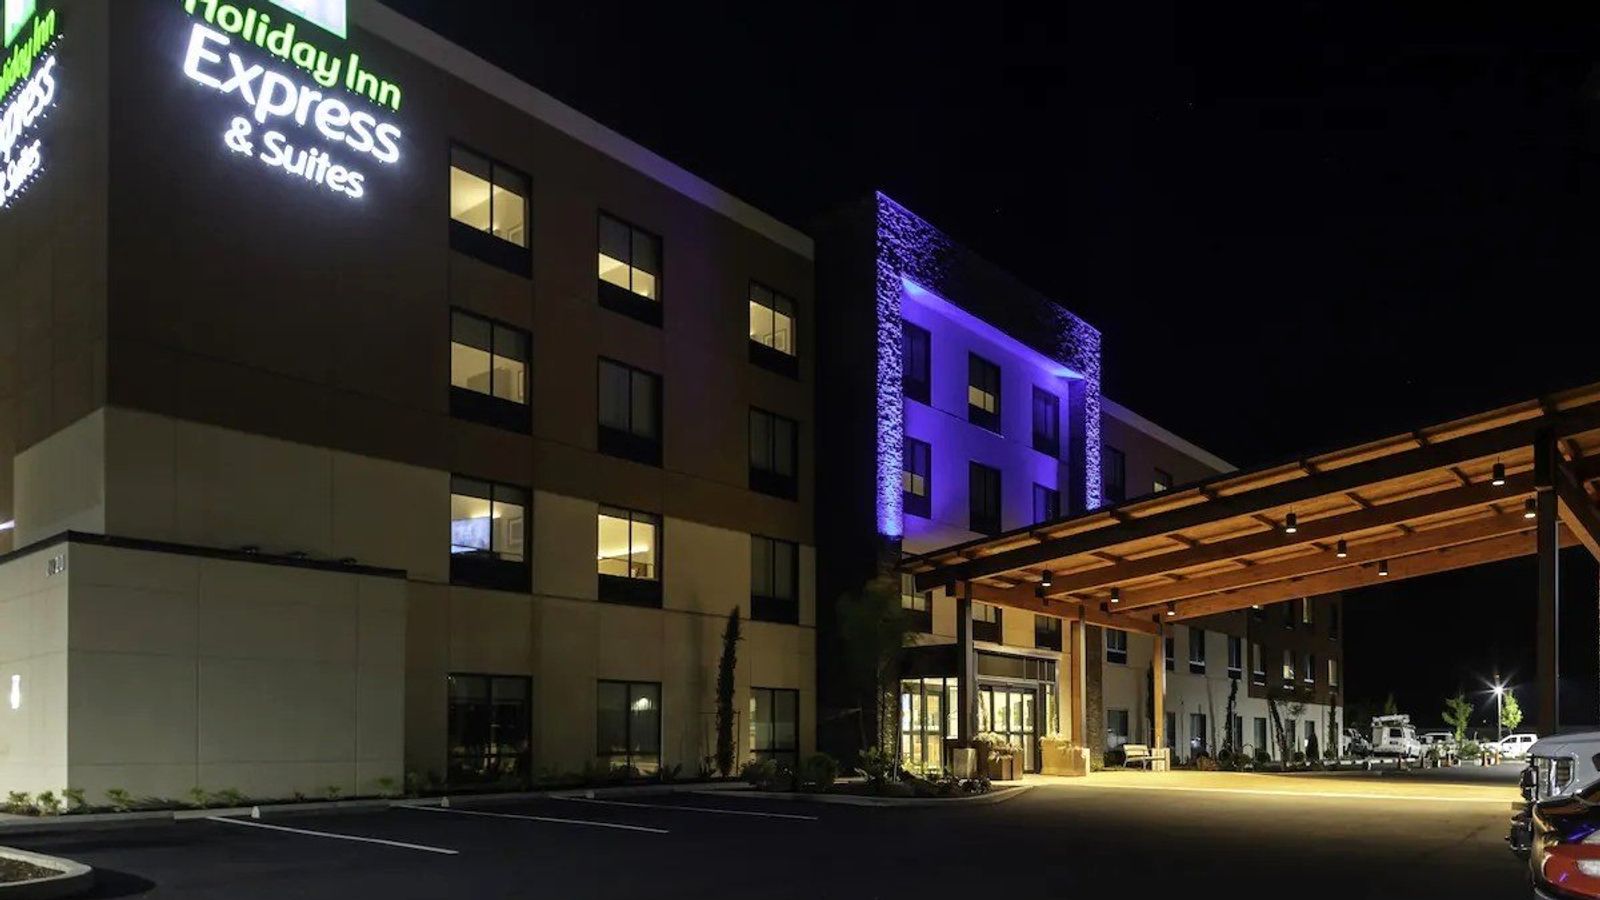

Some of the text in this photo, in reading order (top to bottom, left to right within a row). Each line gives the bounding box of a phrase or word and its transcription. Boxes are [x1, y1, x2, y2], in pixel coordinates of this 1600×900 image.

[184, 23, 402, 163] Express
[346, 53, 401, 110] Inn
[224, 116, 365, 198] & Suites
